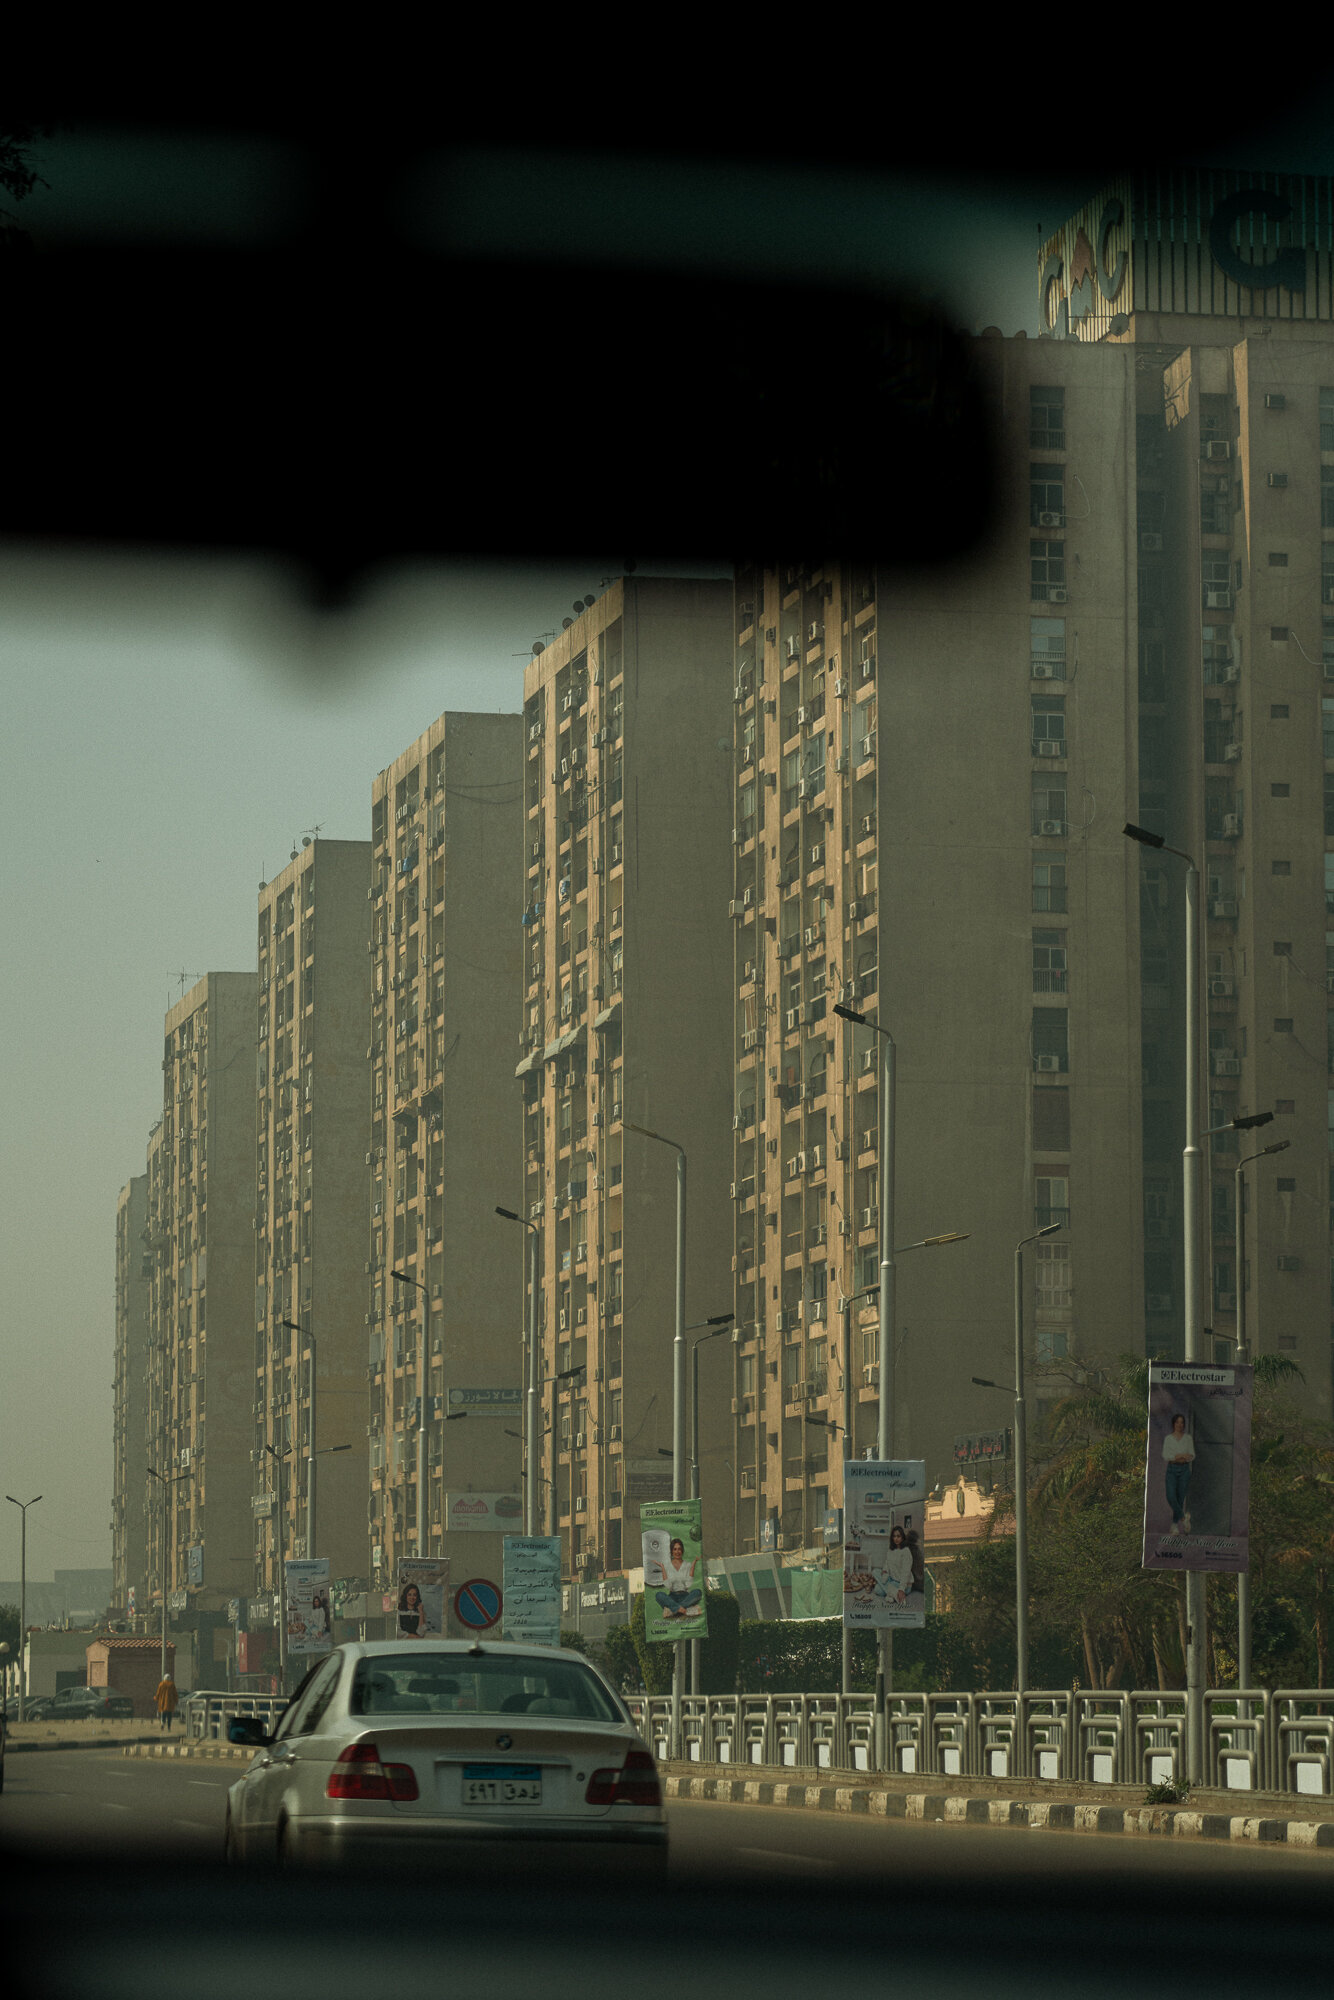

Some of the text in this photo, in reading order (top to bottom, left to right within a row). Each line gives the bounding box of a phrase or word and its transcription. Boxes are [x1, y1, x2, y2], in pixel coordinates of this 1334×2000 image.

[1170, 1370, 1226, 1383] Electrostar
[858, 1468, 902, 1478] Electrostar
[651, 1508, 684, 1516] Electrostar
